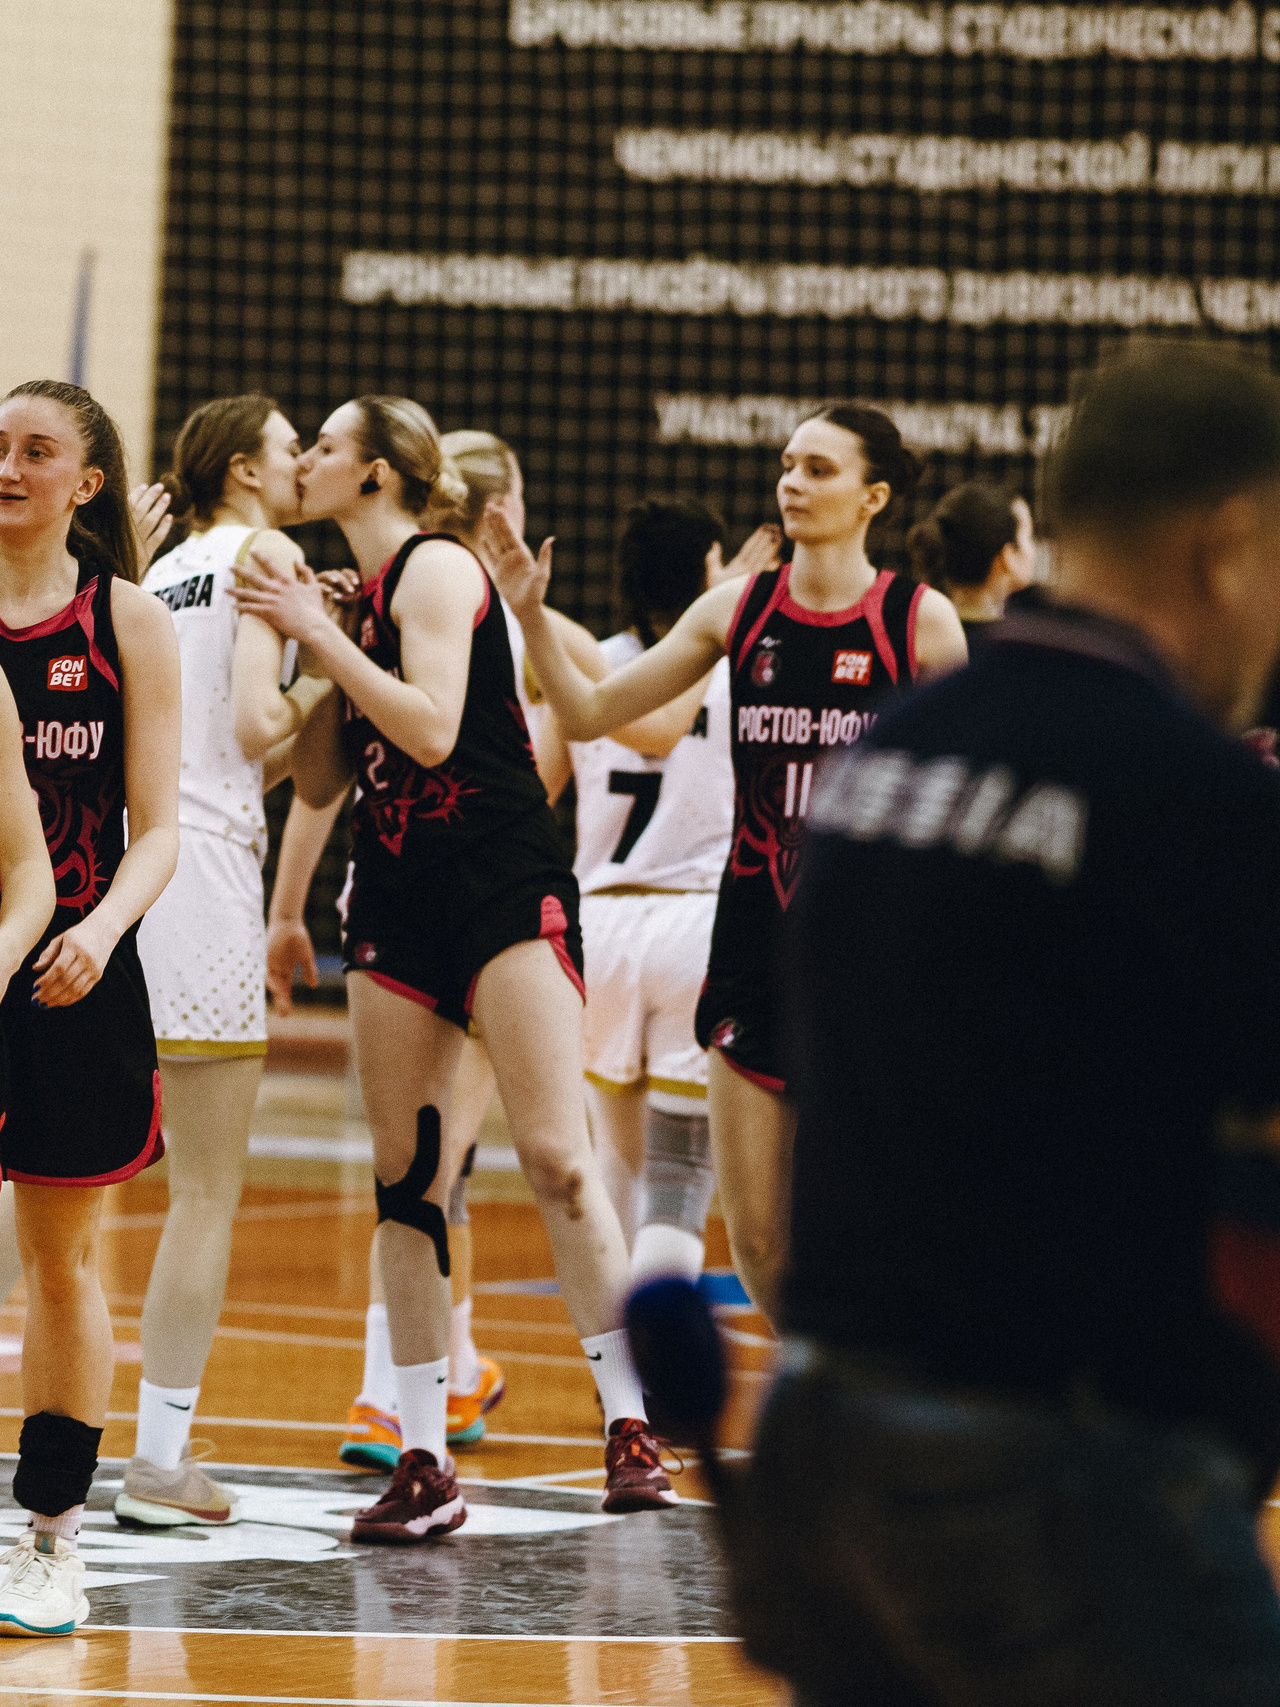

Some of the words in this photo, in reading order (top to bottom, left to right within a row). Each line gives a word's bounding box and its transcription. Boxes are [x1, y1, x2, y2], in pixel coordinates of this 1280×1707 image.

[51, 659, 84, 673] FON
[836, 652, 871, 667] FON
[49, 672, 85, 688] BET
[834, 666, 869, 682] BET
[363, 740, 390, 791] 2
[608, 770, 663, 864] 7
